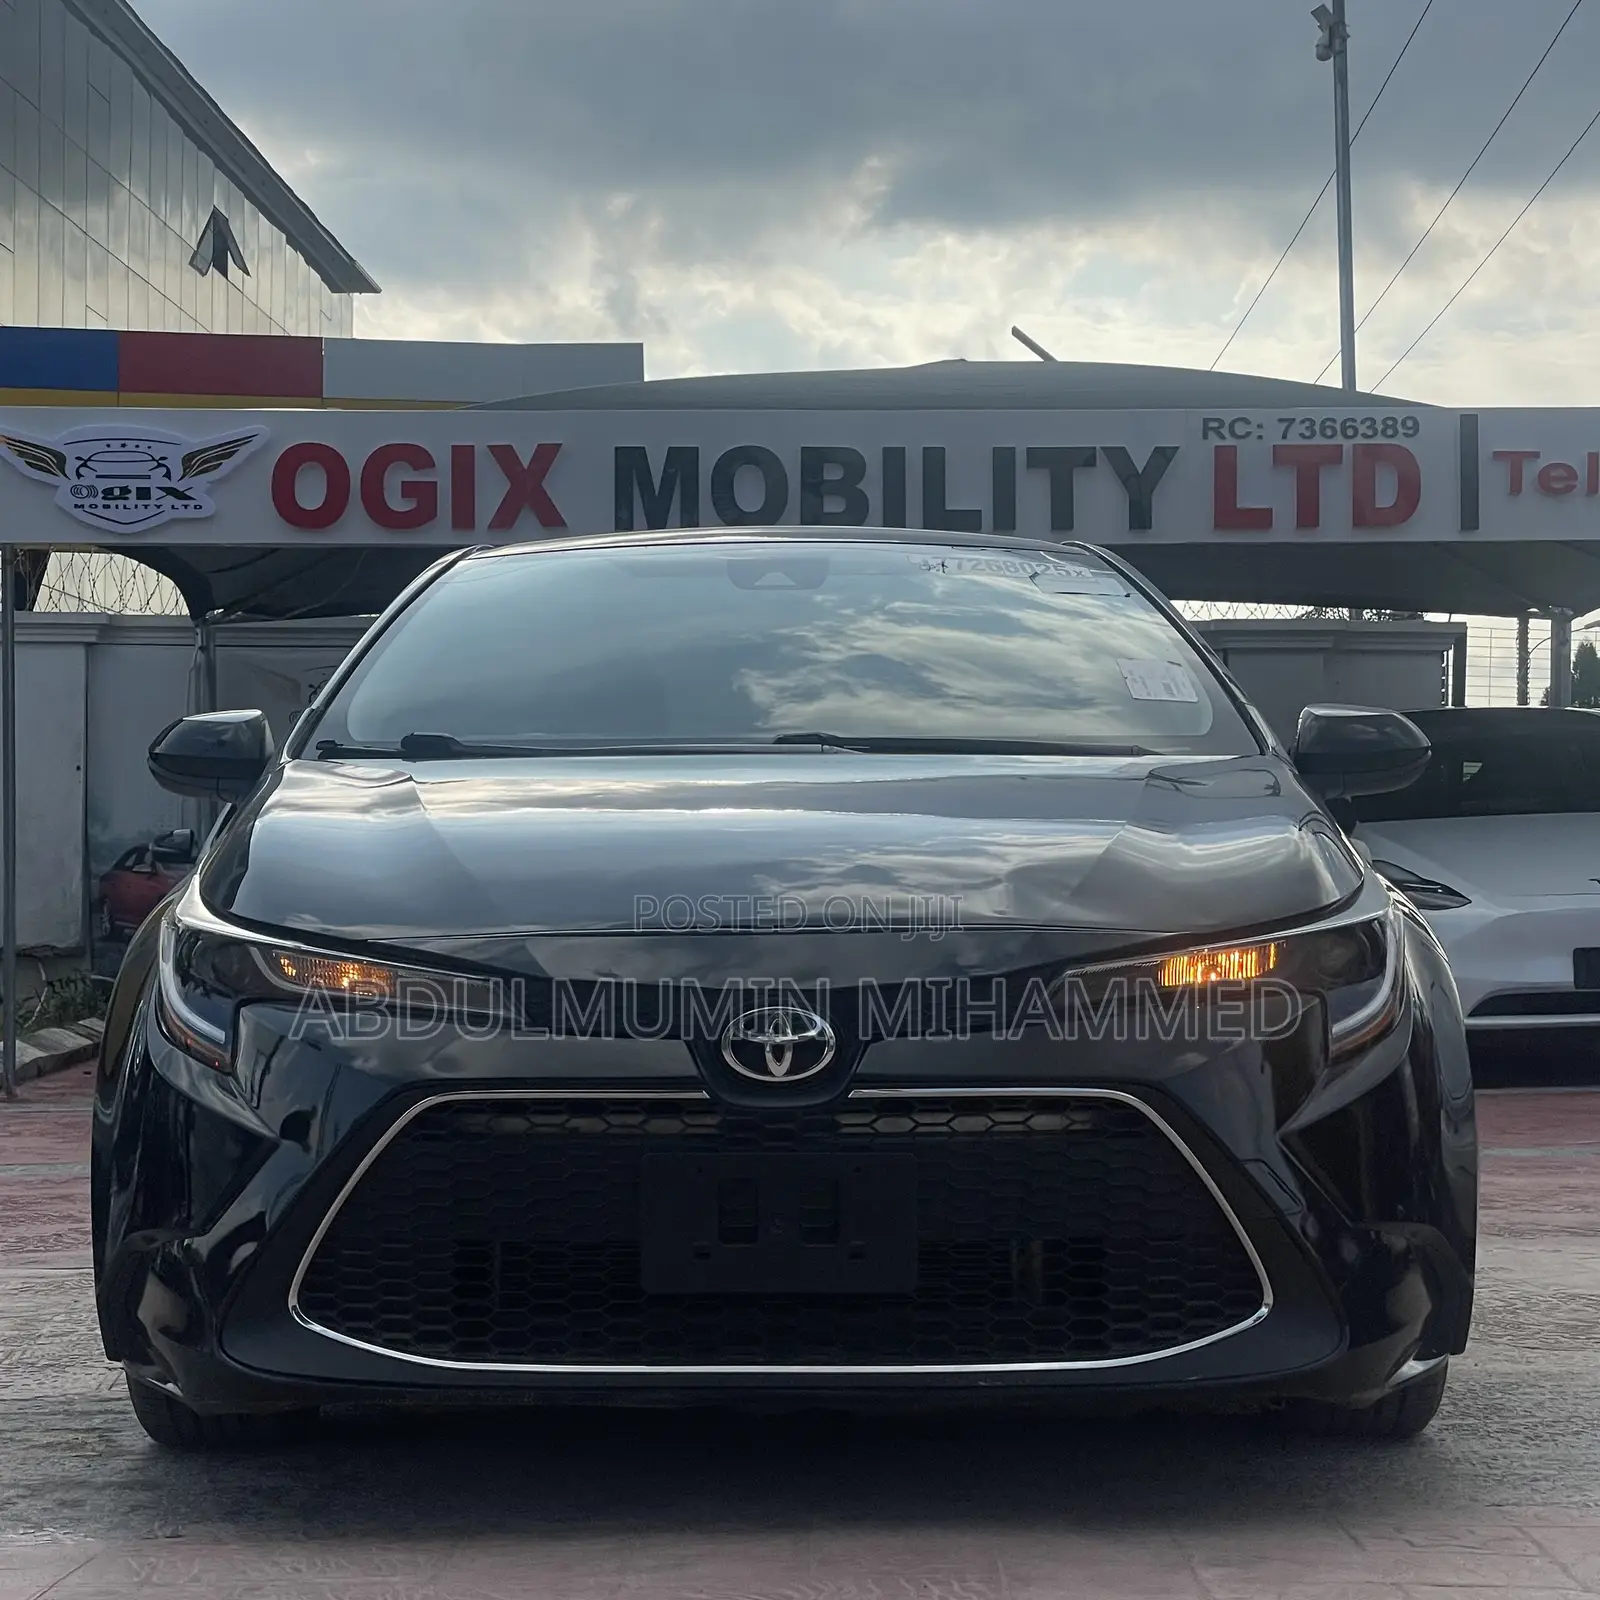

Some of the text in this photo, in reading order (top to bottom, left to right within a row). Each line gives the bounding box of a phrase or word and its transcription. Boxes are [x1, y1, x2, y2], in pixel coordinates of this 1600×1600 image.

[1202, 416, 1421, 441] RC: 7366389
[271, 442, 1422, 531] OGIX MOBILITY LTD
